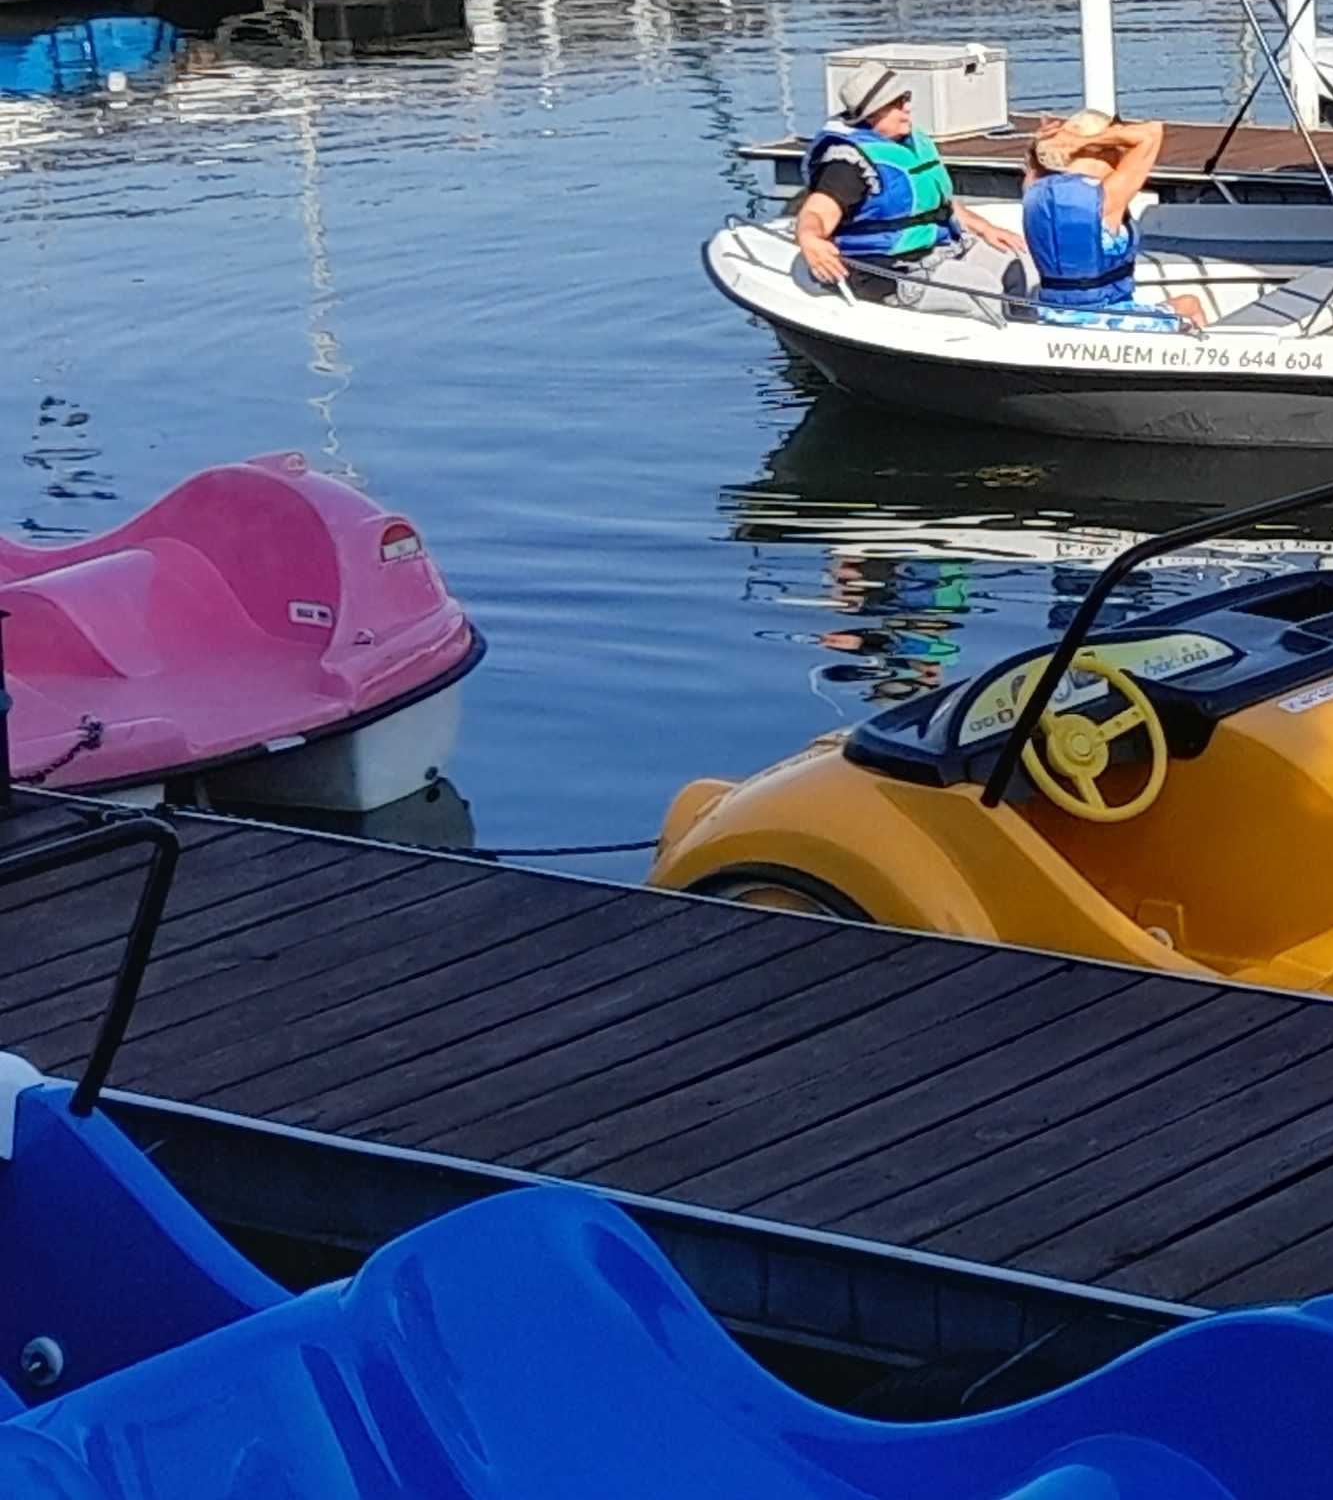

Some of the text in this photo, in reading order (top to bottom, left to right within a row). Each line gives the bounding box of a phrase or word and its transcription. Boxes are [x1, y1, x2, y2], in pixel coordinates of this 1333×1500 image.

[1047, 343, 1153, 365] WYNAJEM
[1239, 350, 1276, 368] 644
[1285, 352, 1323, 370] 604
